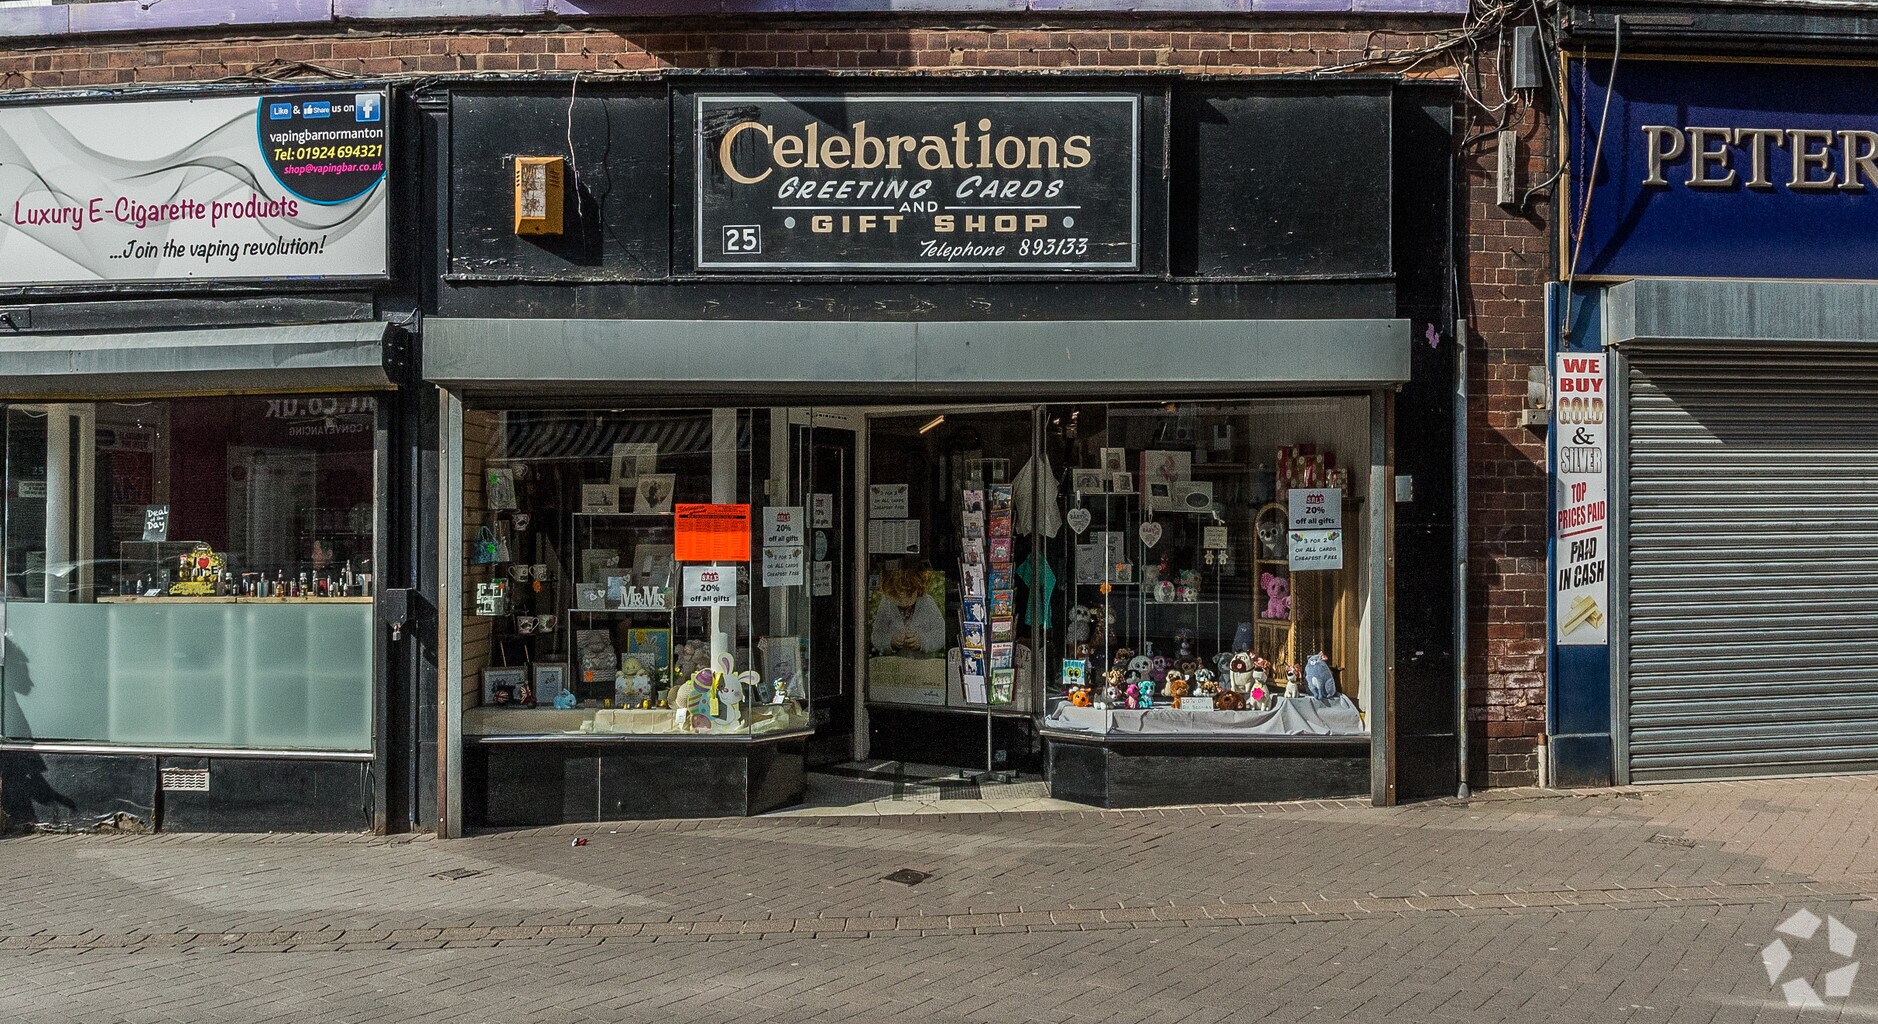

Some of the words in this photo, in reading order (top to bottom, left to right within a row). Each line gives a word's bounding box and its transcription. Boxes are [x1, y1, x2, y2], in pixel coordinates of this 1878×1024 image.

[293, 106, 301, 114] &
[270, 128, 383, 145] vapingbarnormanton
[274, 148, 295, 160] Tel:
[297, 146, 335, 159] 01924
[337, 145, 382, 158] 694321
[720, 119, 1091, 184] Celebrations
[1642, 126, 1878, 189] PETER
[284, 162, 383, 175] shop@vapingbar.co.uk
[777, 177, 931, 199] GREETING
[957, 176, 1064, 198] CARDS
[15, 201, 83, 231] Luxury
[89, 197, 205, 229] E-Cigarette
[212, 195, 298, 228] products
[899, 201, 938, 212] AND
[811, 215, 904, 232] GIFT
[935, 215, 1047, 232] SHOP
[163, 239, 185, 258] the
[190, 241, 239, 264] vaping
[243, 235, 327, 257] revolution!
[726, 230, 757, 251] 25
[920, 239, 1005, 261] Telephone
[1019, 238, 1088, 257] 893133
[1563, 359, 1599, 373] WE
[1560, 378, 1603, 392] BUY
[1559, 397, 1603, 424] GOLD
[1572, 427, 1595, 445] &
[1561, 447, 1602, 473] SILVER
[1307, 495, 1324, 504] SALE
[1571, 482, 1586, 503] TOP
[147, 506, 168, 517] Deal
[1558, 505, 1586, 530] PRICES
[1588, 501, 1605, 523] PAID
[147, 521, 165, 532] Day
[1570, 537, 1597, 563] PAID
[701, 574, 719, 582] SALE
[1559, 567, 1571, 591] IN
[1574, 560, 1605, 587] CASH
